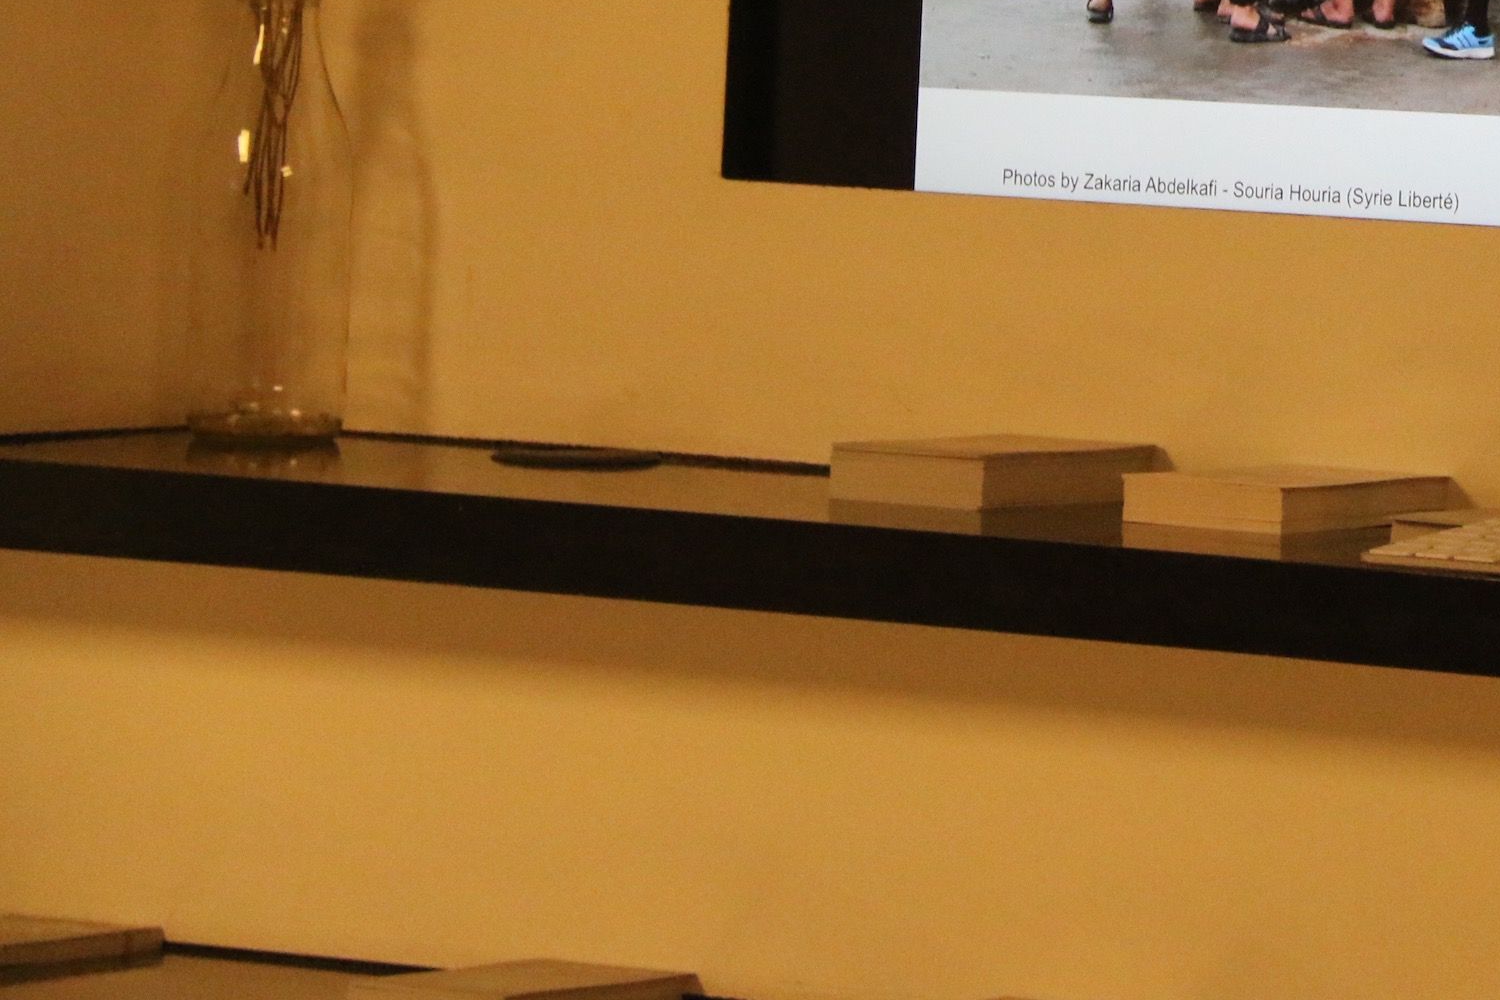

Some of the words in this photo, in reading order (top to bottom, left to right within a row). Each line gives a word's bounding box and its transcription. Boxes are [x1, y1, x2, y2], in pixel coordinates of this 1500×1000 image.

[1002, 168, 1056, 189] Photos
[1060, 171, 1079, 194] by
[1083, 172, 1141, 193] Zakaria
[1145, 175, 1217, 197] Abdelkafi
[1233, 179, 1284, 200] Souria
[1289, 182, 1341, 203] Houria
[1346, 185, 1393, 209] (Syrie
[1397, 187, 1460, 213] Liberté)
